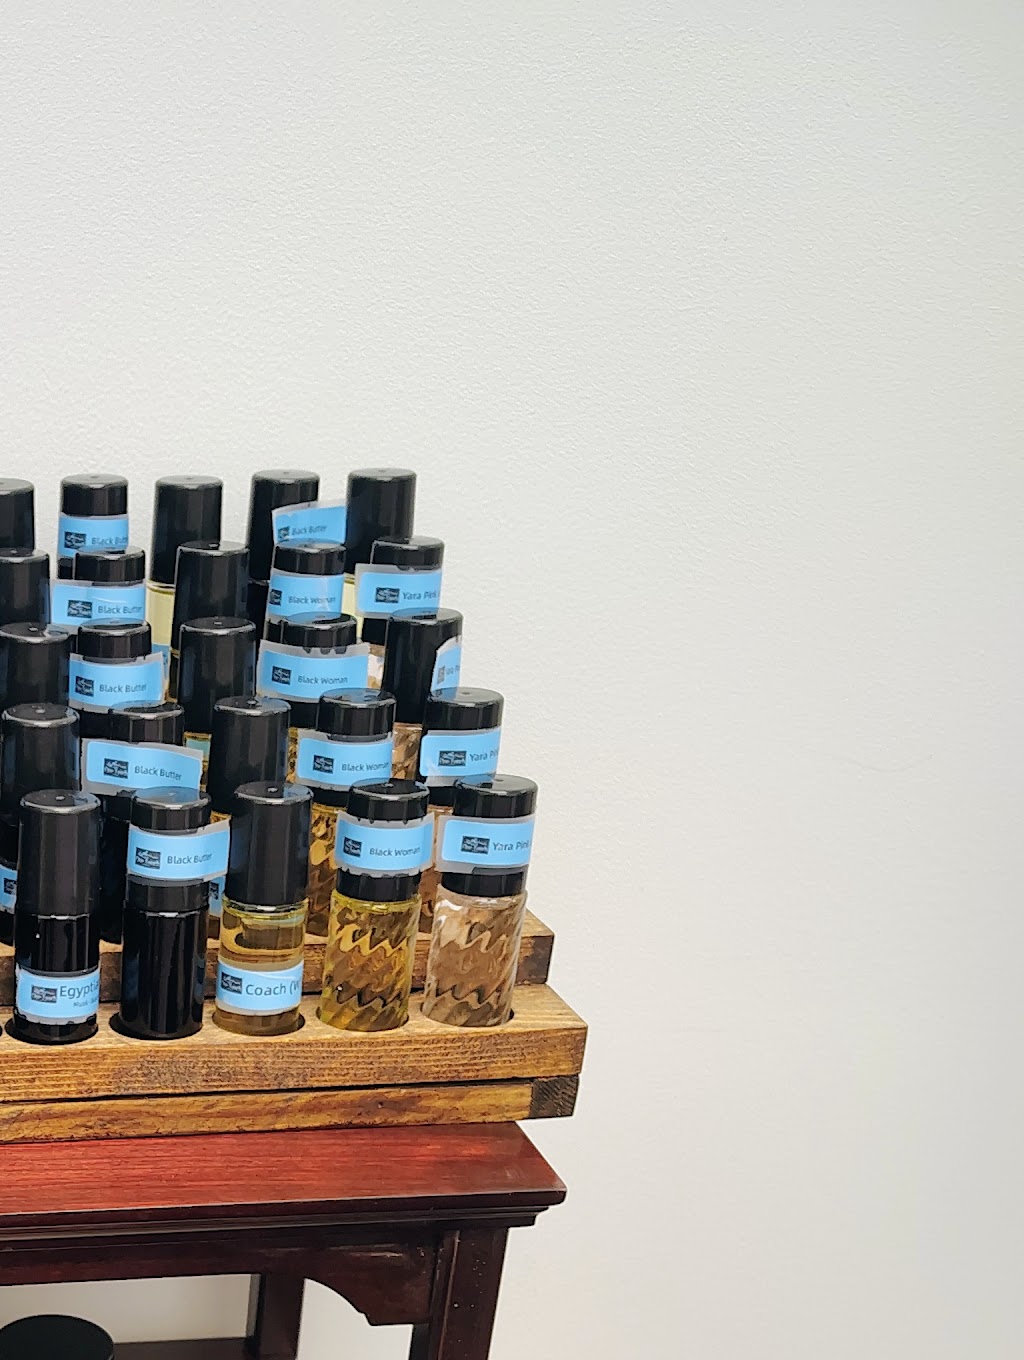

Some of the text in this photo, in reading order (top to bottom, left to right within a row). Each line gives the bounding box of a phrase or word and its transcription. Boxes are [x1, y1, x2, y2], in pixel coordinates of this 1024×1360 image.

[402, 591, 422, 601] Yara
[97, 605, 121, 614] Black
[297, 675, 319, 685] Black
[320, 676, 349, 685] Woman
[99, 684, 123, 693] Black
[469, 752, 488, 762] Yara
[341, 763, 364, 772] Black
[134, 765, 158, 777] Black
[159, 769, 182, 781] Butter
[492, 841, 514, 851] Yara
[369, 846, 393, 857] Black
[394, 846, 421, 857] Woman
[167, 855, 193, 865] Black
[245, 982, 287, 997] Coach
